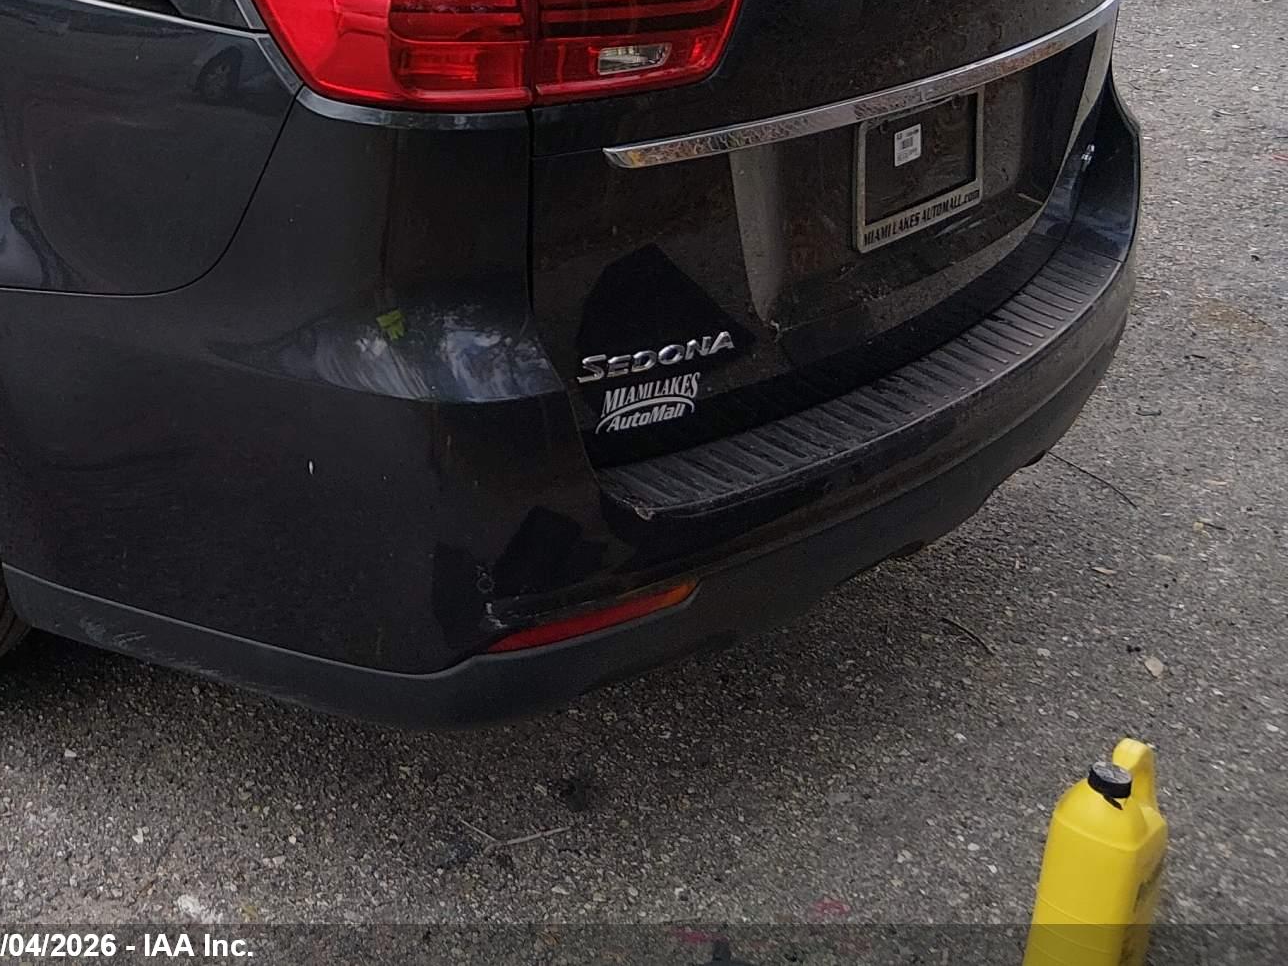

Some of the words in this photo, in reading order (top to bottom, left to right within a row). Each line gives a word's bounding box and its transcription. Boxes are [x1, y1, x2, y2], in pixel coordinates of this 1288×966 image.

[576, 330, 735, 384] SEDONA
[600, 380, 652, 419] MIAMI
[653, 371, 701, 399] LAKES
[606, 402, 686, 433] AutoMall
